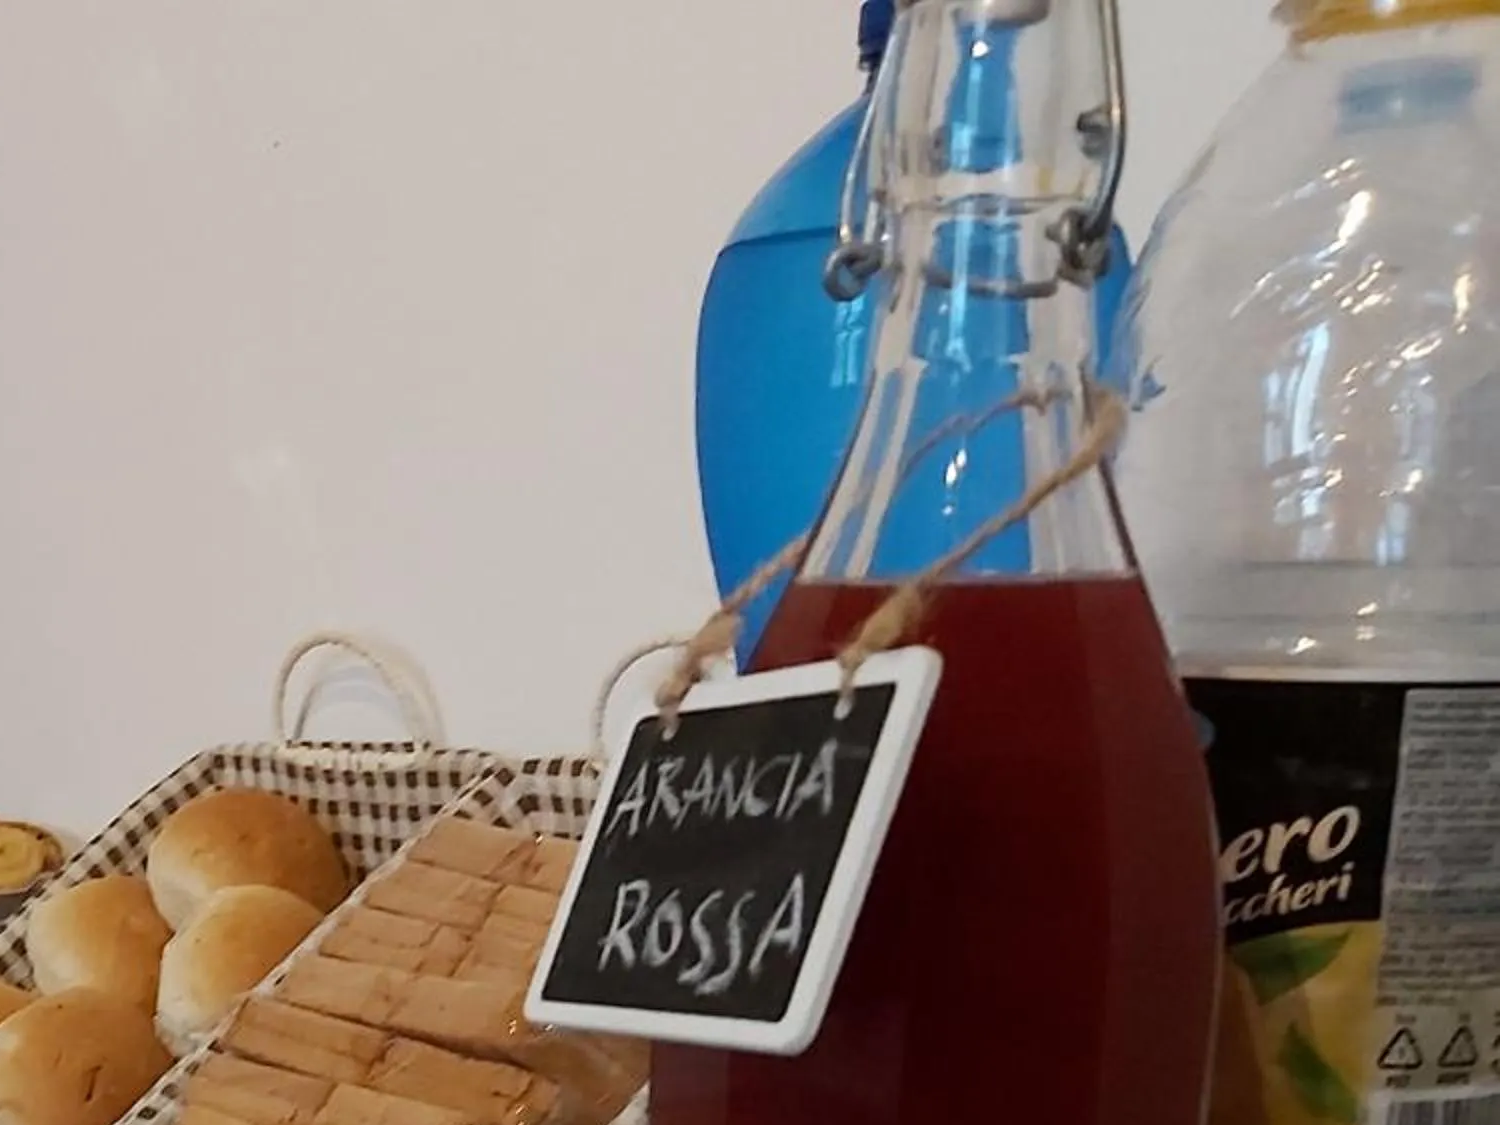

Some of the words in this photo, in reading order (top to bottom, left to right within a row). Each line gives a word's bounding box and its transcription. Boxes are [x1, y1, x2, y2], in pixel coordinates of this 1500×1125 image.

[604, 737, 838, 840] ARANCIA
[1219, 804, 1361, 884] ero
[599, 873, 805, 996] ROSSA
[1221, 861, 1355, 927] ccheri
